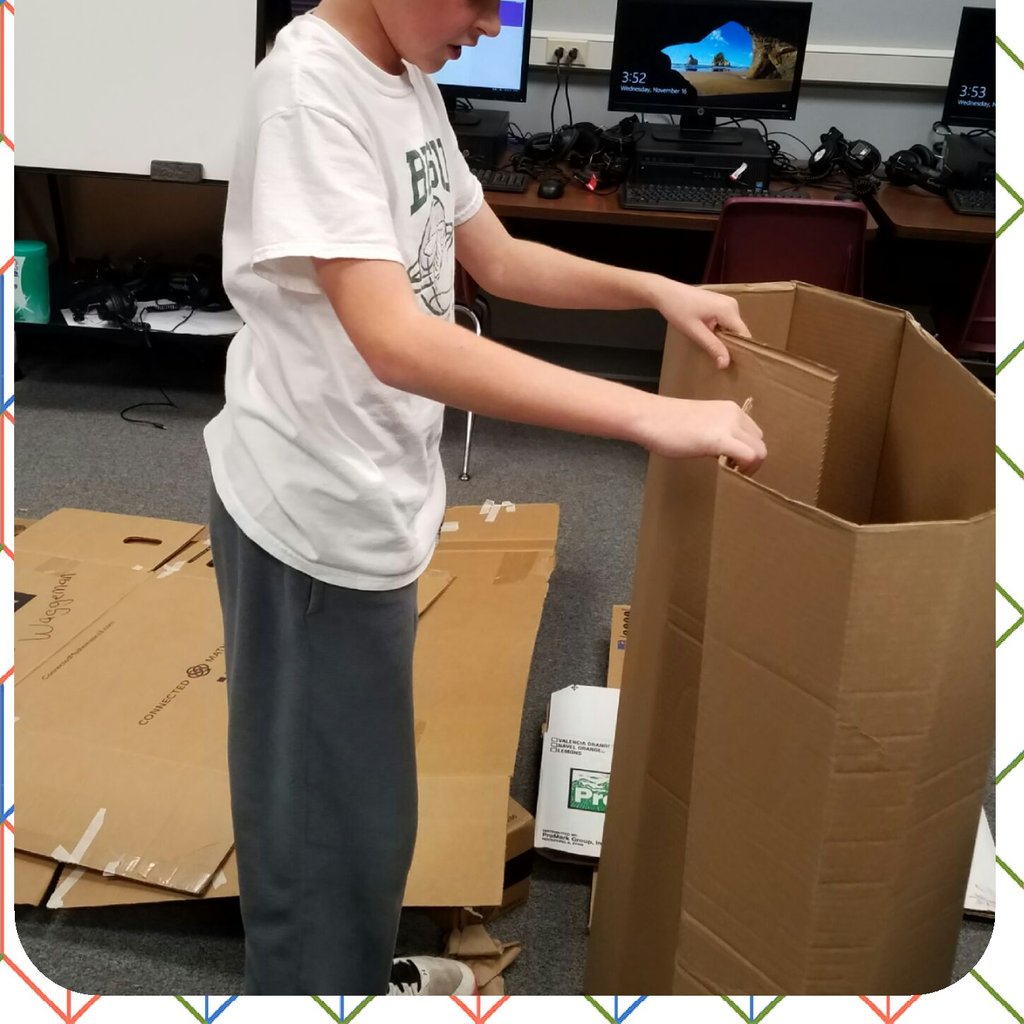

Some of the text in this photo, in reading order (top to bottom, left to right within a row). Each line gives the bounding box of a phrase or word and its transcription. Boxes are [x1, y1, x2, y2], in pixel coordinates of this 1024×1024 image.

[621, 71, 647, 84] 3:52
[620, 85, 652, 93] Wednesday,
[959, 85, 986, 98] 3:53
[138, 679, 190, 725] CONNECTED
